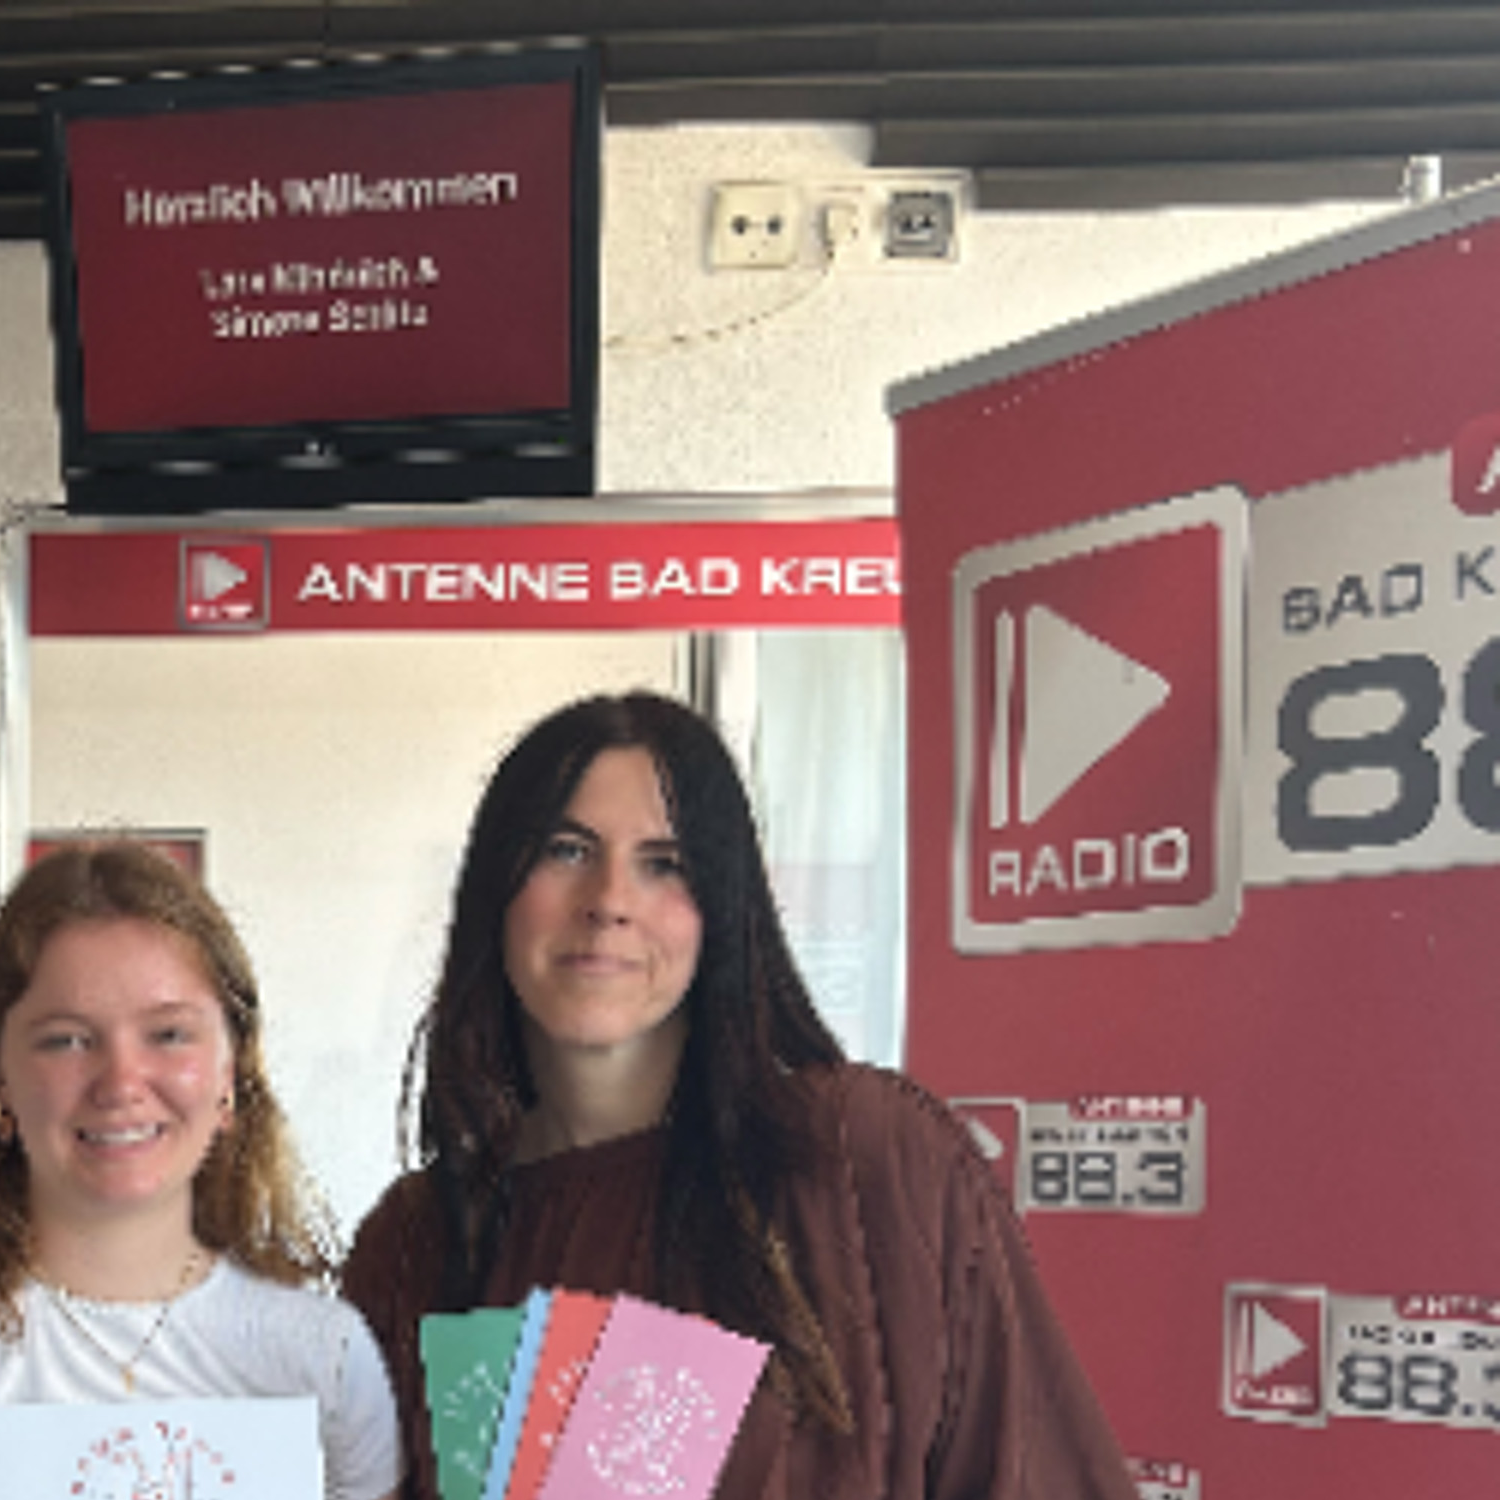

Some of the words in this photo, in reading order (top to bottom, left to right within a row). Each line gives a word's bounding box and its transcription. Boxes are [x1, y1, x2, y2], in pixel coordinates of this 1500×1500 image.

[123, 176, 278, 228] Herzlich
[281, 170, 518, 216] Willkommen
[298, 562, 590, 602] ANTENNE
[610, 557, 740, 602] BAD
[1282, 563, 1424, 636] BAD
[989, 827, 1190, 898] RADIO
[1031, 1152, 1184, 1204] 88.3
